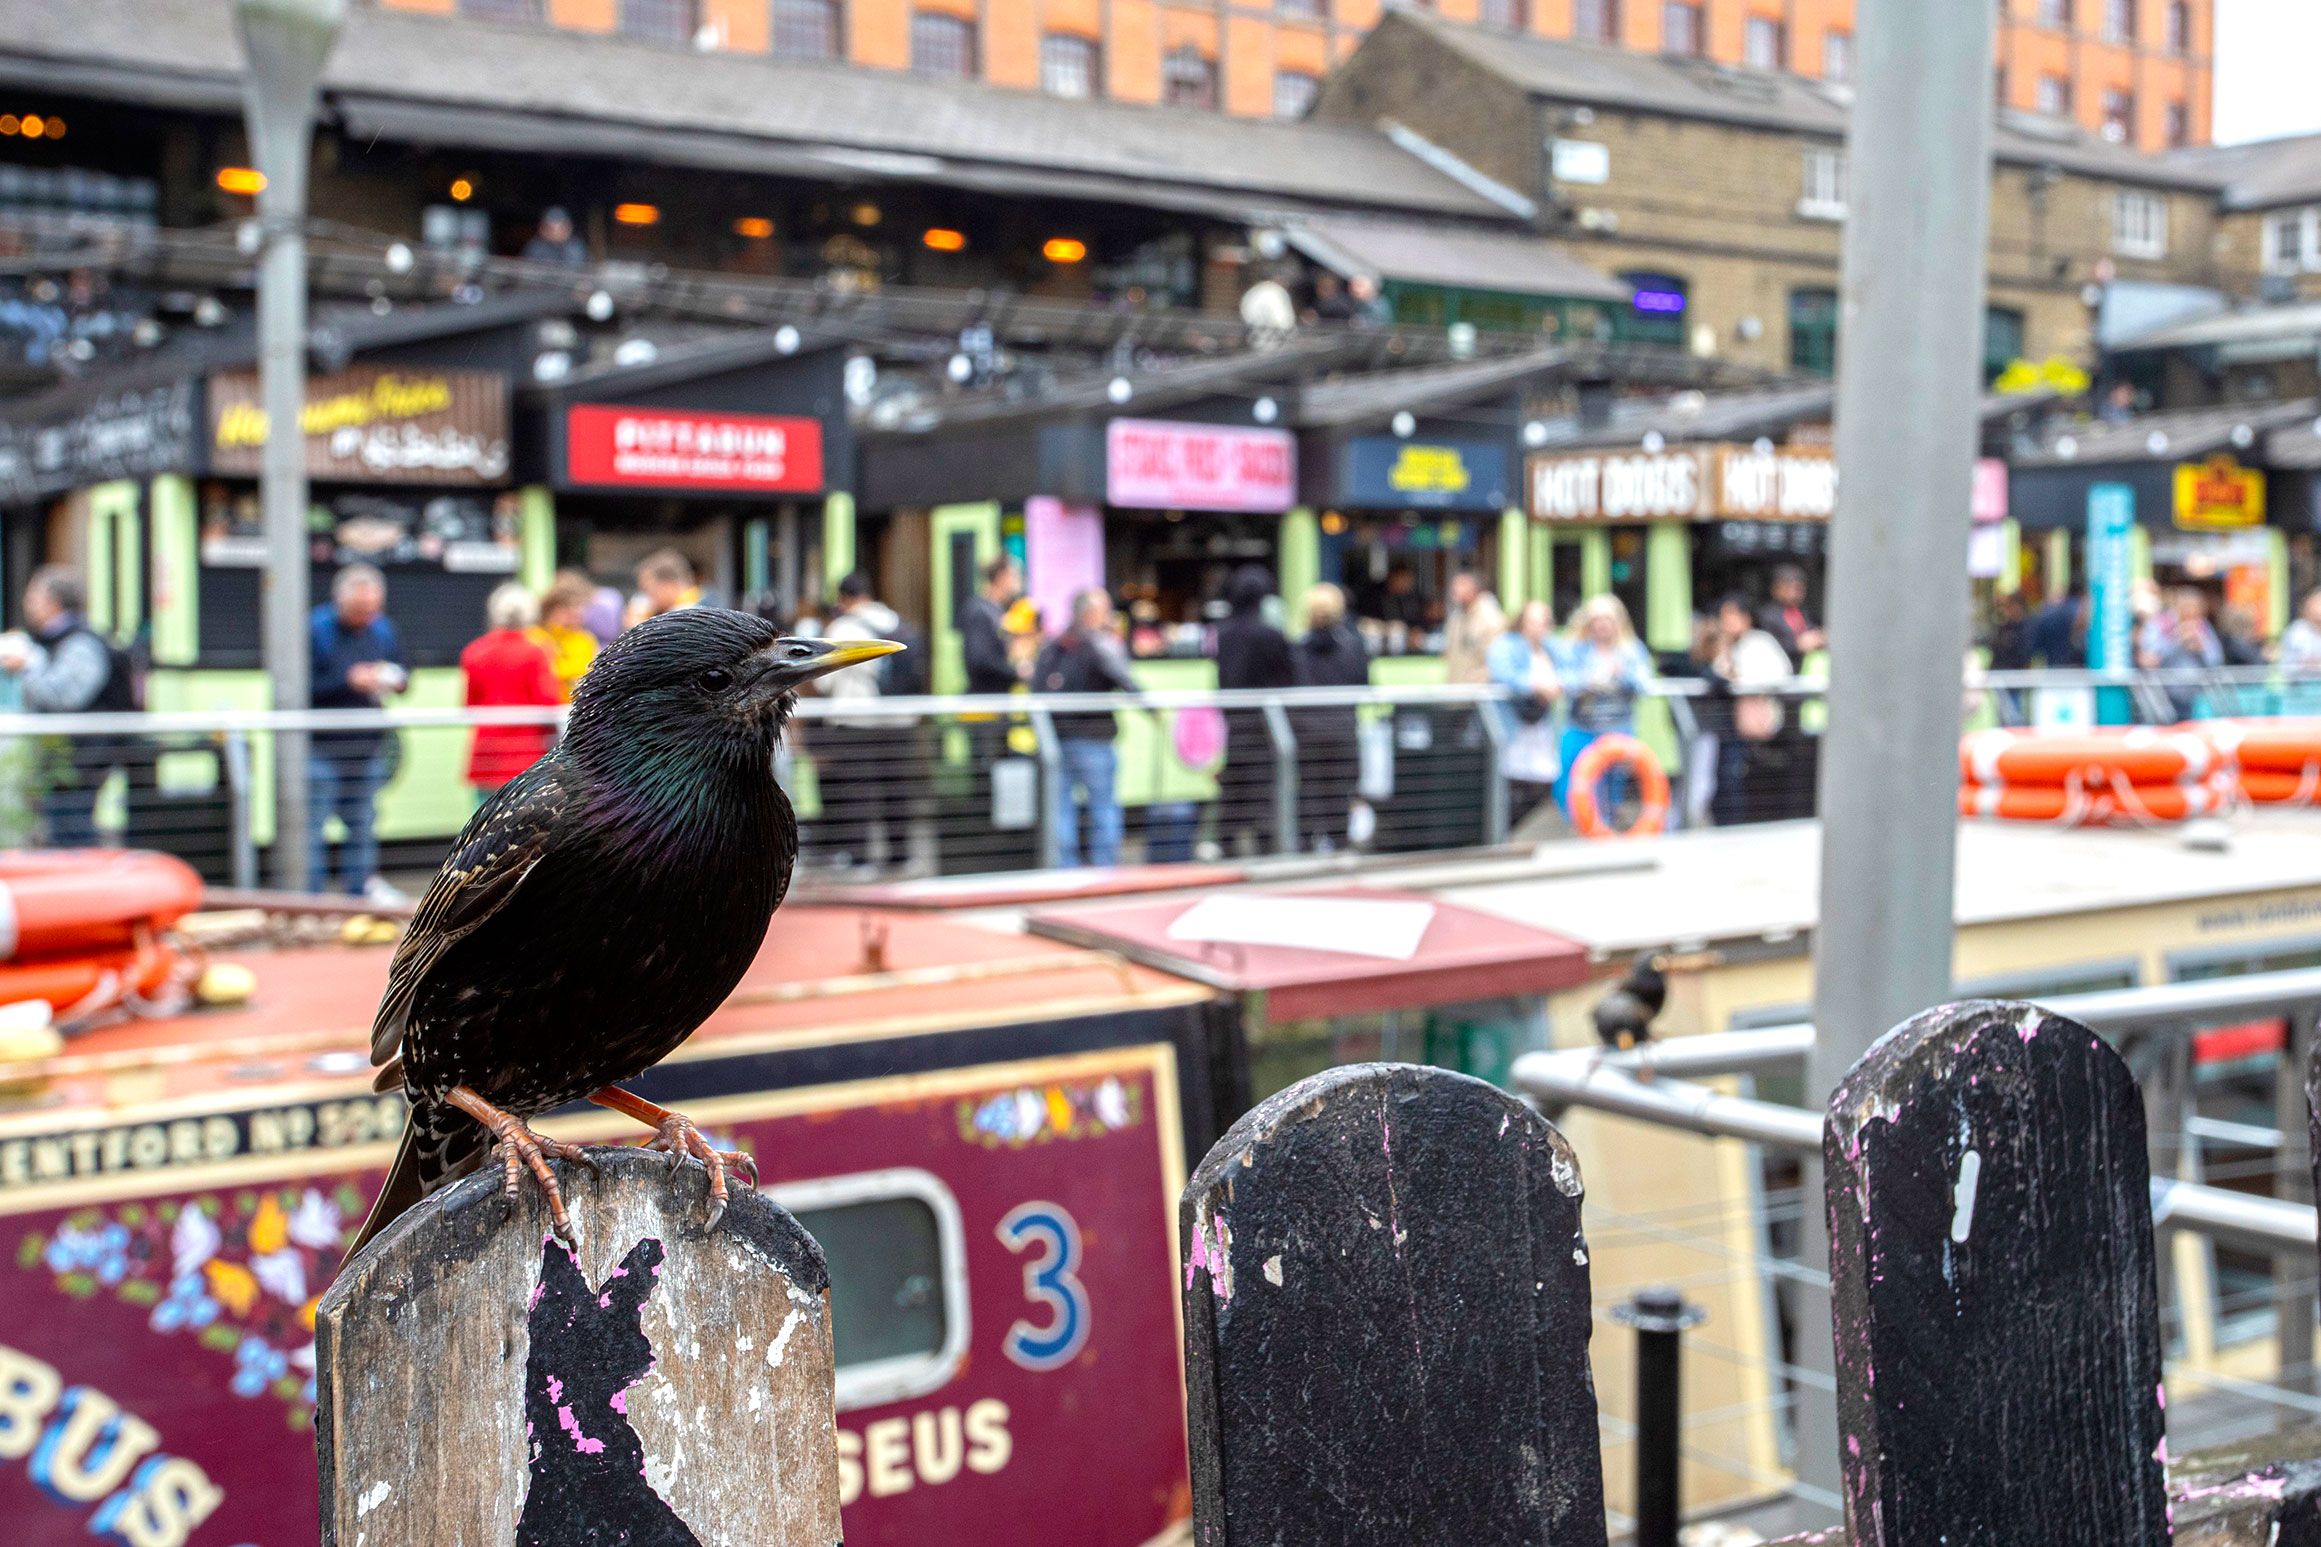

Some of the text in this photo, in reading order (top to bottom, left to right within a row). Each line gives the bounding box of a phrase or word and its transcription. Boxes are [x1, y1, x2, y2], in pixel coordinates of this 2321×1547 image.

[1533, 456, 1599, 518] HOT
[1601, 453, 1698, 517] DOGS
[1722, 453, 1776, 513] HOT
[994, 1200, 1092, 1371] 3
[0, 1343, 226, 1547] BUS
[837, 1396, 1014, 1508] SEUS
